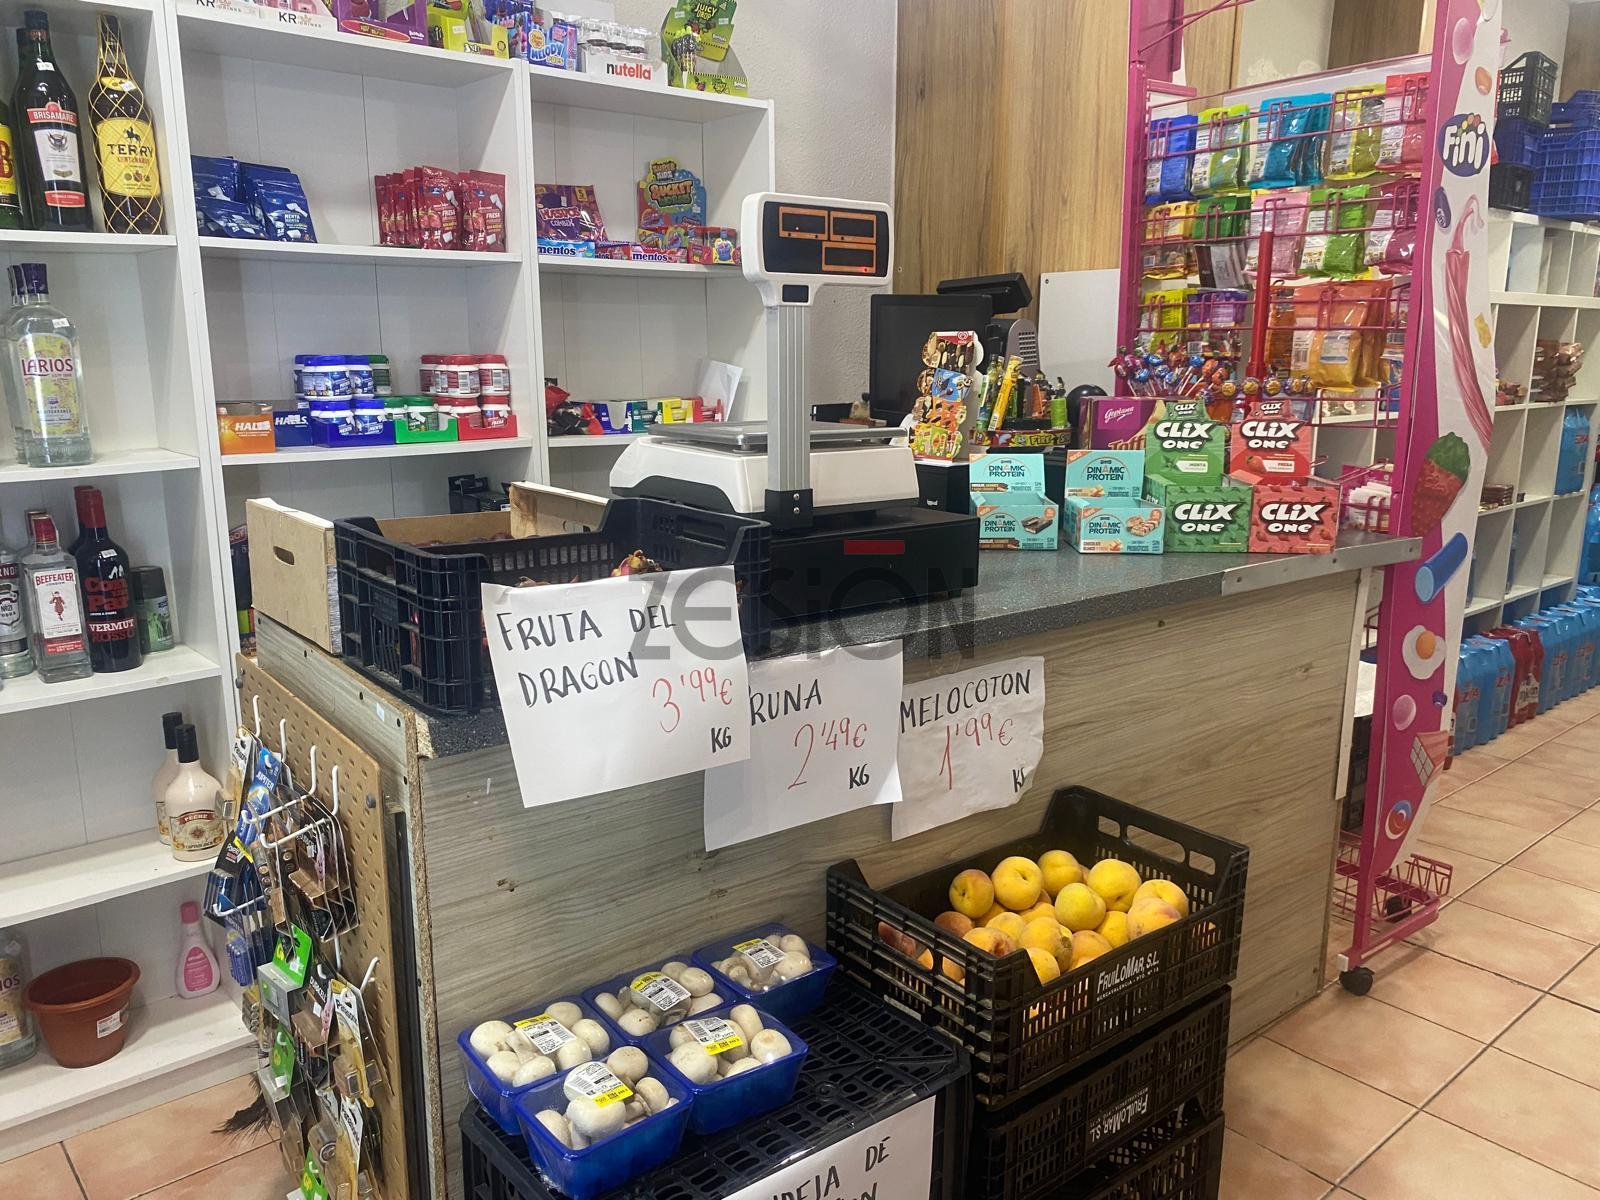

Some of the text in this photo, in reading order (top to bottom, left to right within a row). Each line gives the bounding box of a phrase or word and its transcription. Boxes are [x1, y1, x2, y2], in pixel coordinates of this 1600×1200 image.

[278, 12, 298, 24] KR
[695, 3, 718, 16] JUICY
[696, 11, 712, 20] DROP
[530, 43, 564, 60] MELODY
[607, 62, 651, 80] nutella
[33, 111, 74, 122] BRISAMARE
[107, 143, 153, 157] TERRY
[1442, 122, 1485, 170] Fini
[633, 252, 668, 262] mentos
[21, 358, 74, 376] LARIOS
[988, 464, 1026, 472] DINAMIC
[1086, 465, 1125, 474] DINAMIC
[1086, 473, 1124, 481] PROTEIN
[35, 572, 75, 586] BEEFEATER
[89, 619, 135, 632] VERMUT
[496, 604, 677, 652] FRUTA DEL
[92, 630, 135, 643] ROSSO
[517, 651, 640, 709] DRAGON
[750, 678, 823, 726] RUNA
[900, 669, 1031, 734] MELOCOTON
[711, 726, 732, 753] KG
[255, 771, 275, 792] JUPITER
[849, 763, 870, 790] KG
[0, 974, 21, 991] IOS
[309, 975, 326, 1004] DURACELL
[865, 1136, 891, 1172] DE
